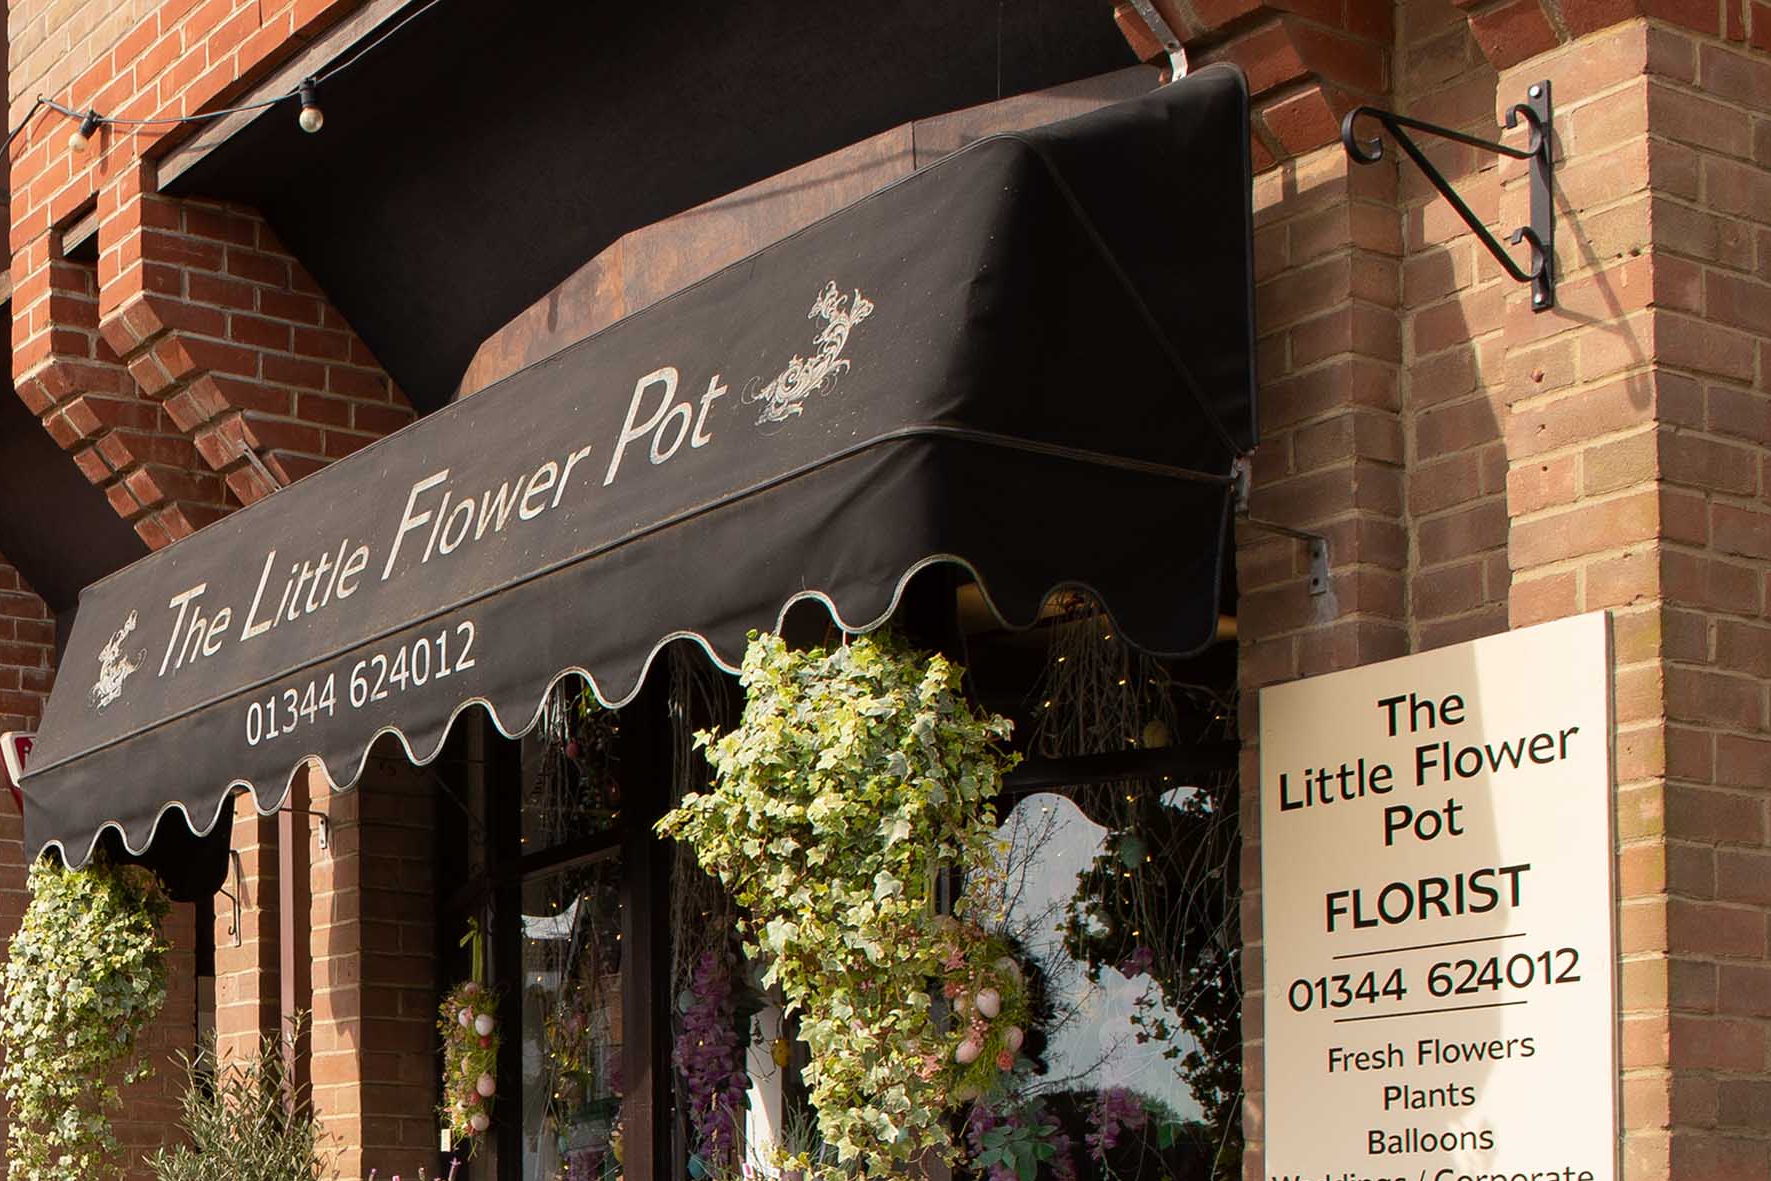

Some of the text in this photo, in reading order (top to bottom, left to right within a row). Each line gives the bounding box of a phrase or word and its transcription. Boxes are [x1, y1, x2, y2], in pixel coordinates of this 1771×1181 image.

[158, 366, 728, 678] The Little Flower Pot
[246, 620, 477, 746] 01344 624012
[1377, 692, 1466, 737] The
[1279, 726, 1581, 812] Little Flower
[1384, 797, 1465, 847] Pot
[1326, 863, 1531, 933] FLORIST
[1288, 947, 1581, 1013] 01344 624012
[1328, 1037, 1535, 1073] Fresh Flowers
[1384, 1083, 1476, 1111] Plants
[1368, 1127, 1494, 1155] Balloons
